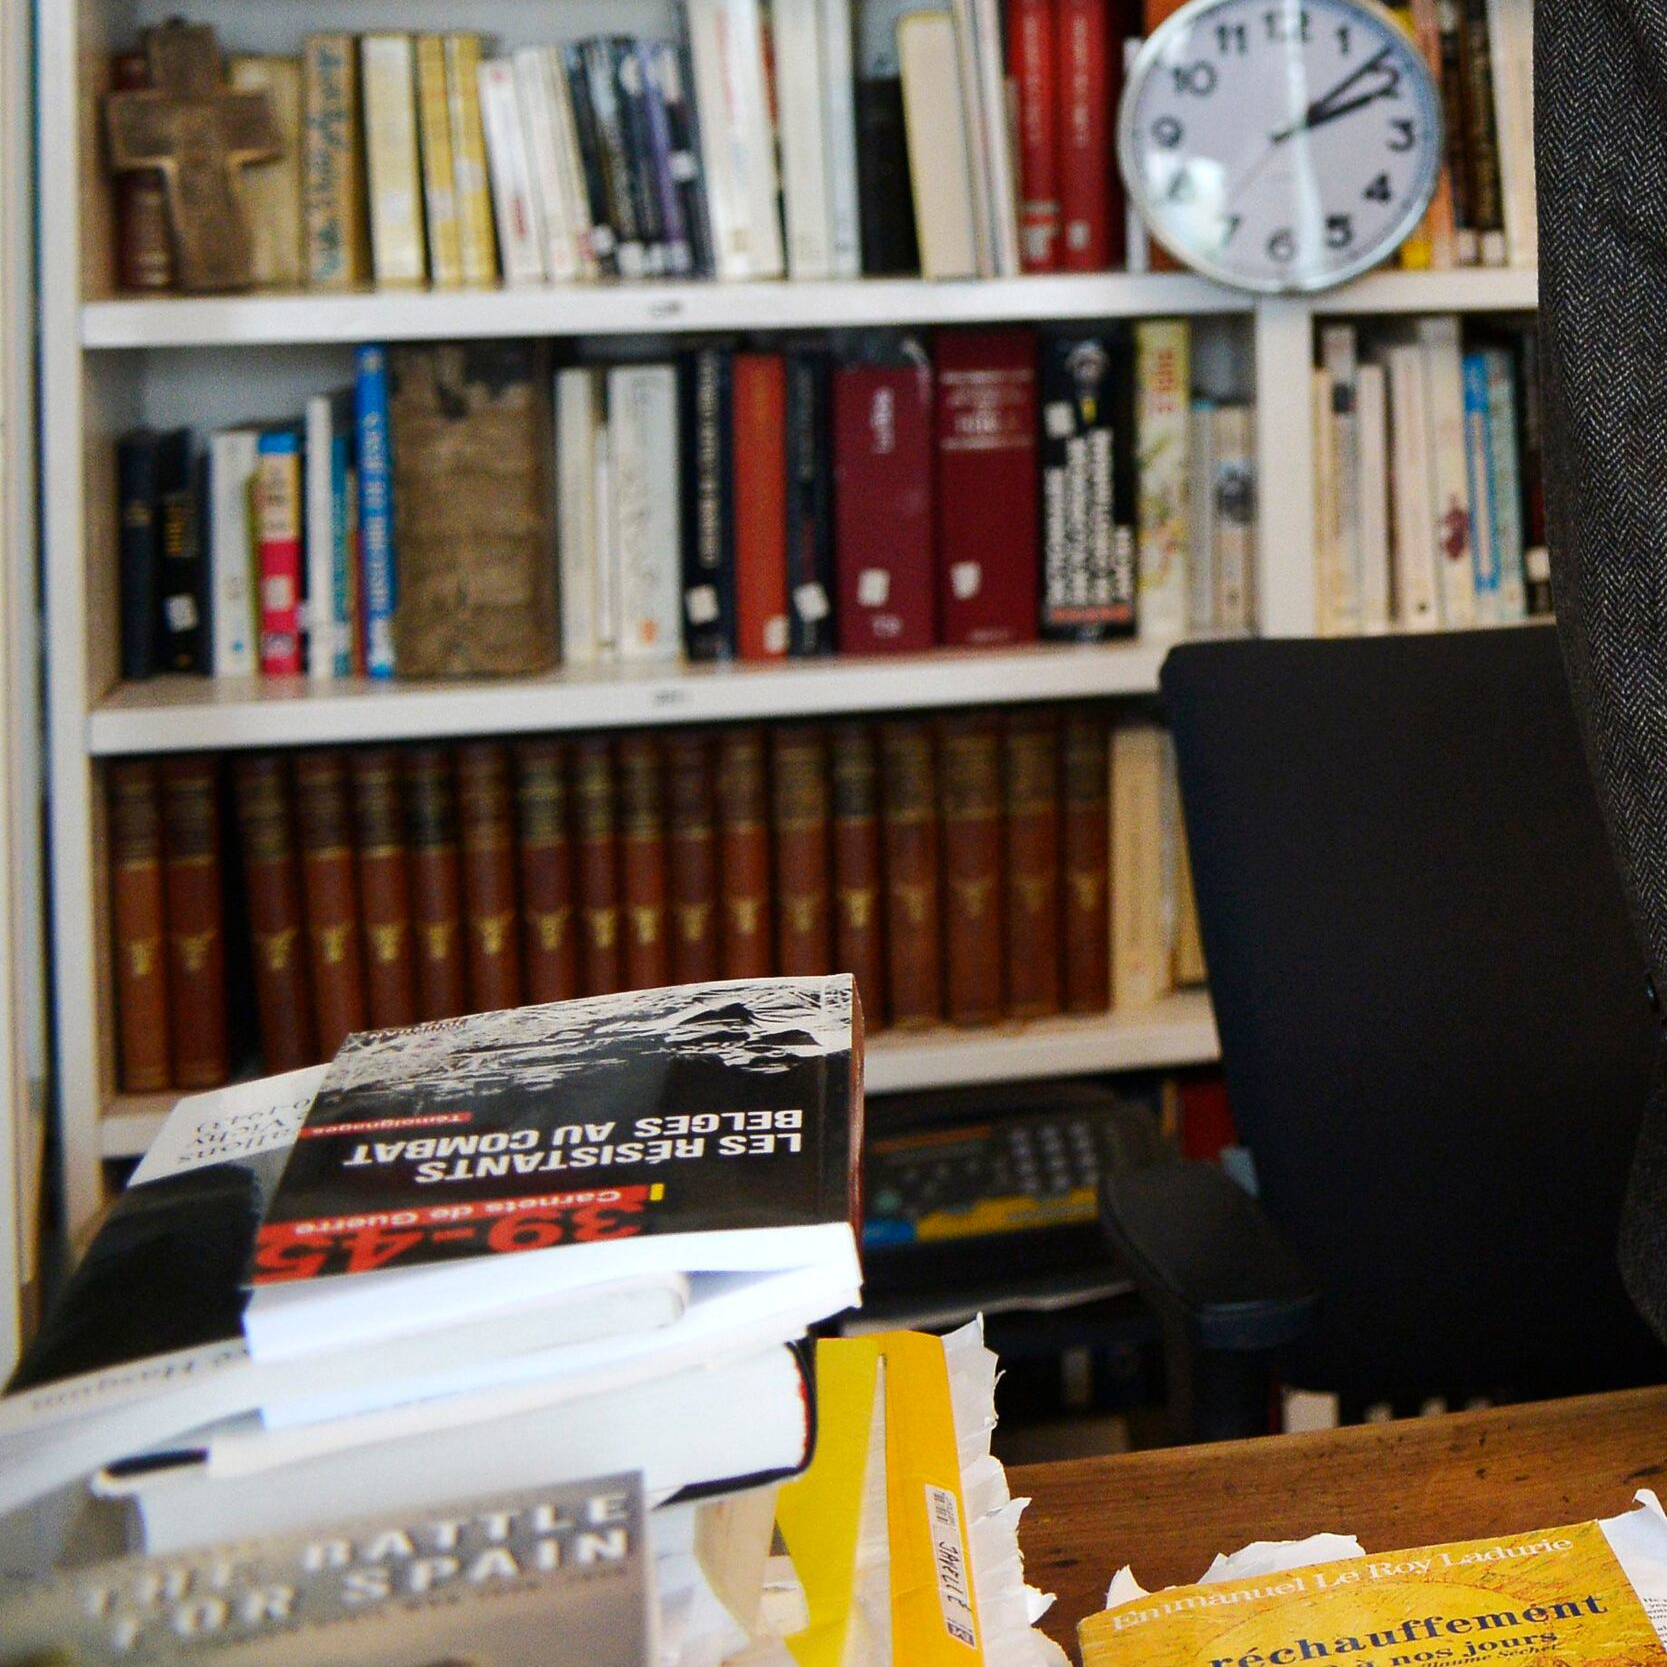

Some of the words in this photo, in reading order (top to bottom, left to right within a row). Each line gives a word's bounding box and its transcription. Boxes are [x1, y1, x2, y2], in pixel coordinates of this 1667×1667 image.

[1386, 118, 1415, 152] 3
[1325, 214, 1352, 249] 5
[552, 1121, 615, 1147] AU
[635, 1109, 803, 1135] BELGES
[344, 1125, 539, 1167] COMBAT
[416, 1135, 696, 1185] RÉSISTANTS
[708, 1132, 803, 1158] LES
[427, 1201, 475, 1223] de
[482, 1187, 622, 1216] Carnets
[253, 1198, 645, 1284] 39-45
[294, 1209, 419, 1238] Guerre
[303, 1491, 630, 1572] BATTLE
[341, 1528, 629, 1602] SPAIN
[1112, 1577, 1305, 1632] Emmanuel
[1315, 1570, 1364, 1591] Le
[1364, 1555, 1434, 1582] Roy
[1441, 1535, 1574, 1568] Ladurie
[1207, 1594, 1610, 1667] réchauffement
[1389, 1646, 1458, 1667] nos
[1464, 1631, 1557, 1661] jours
